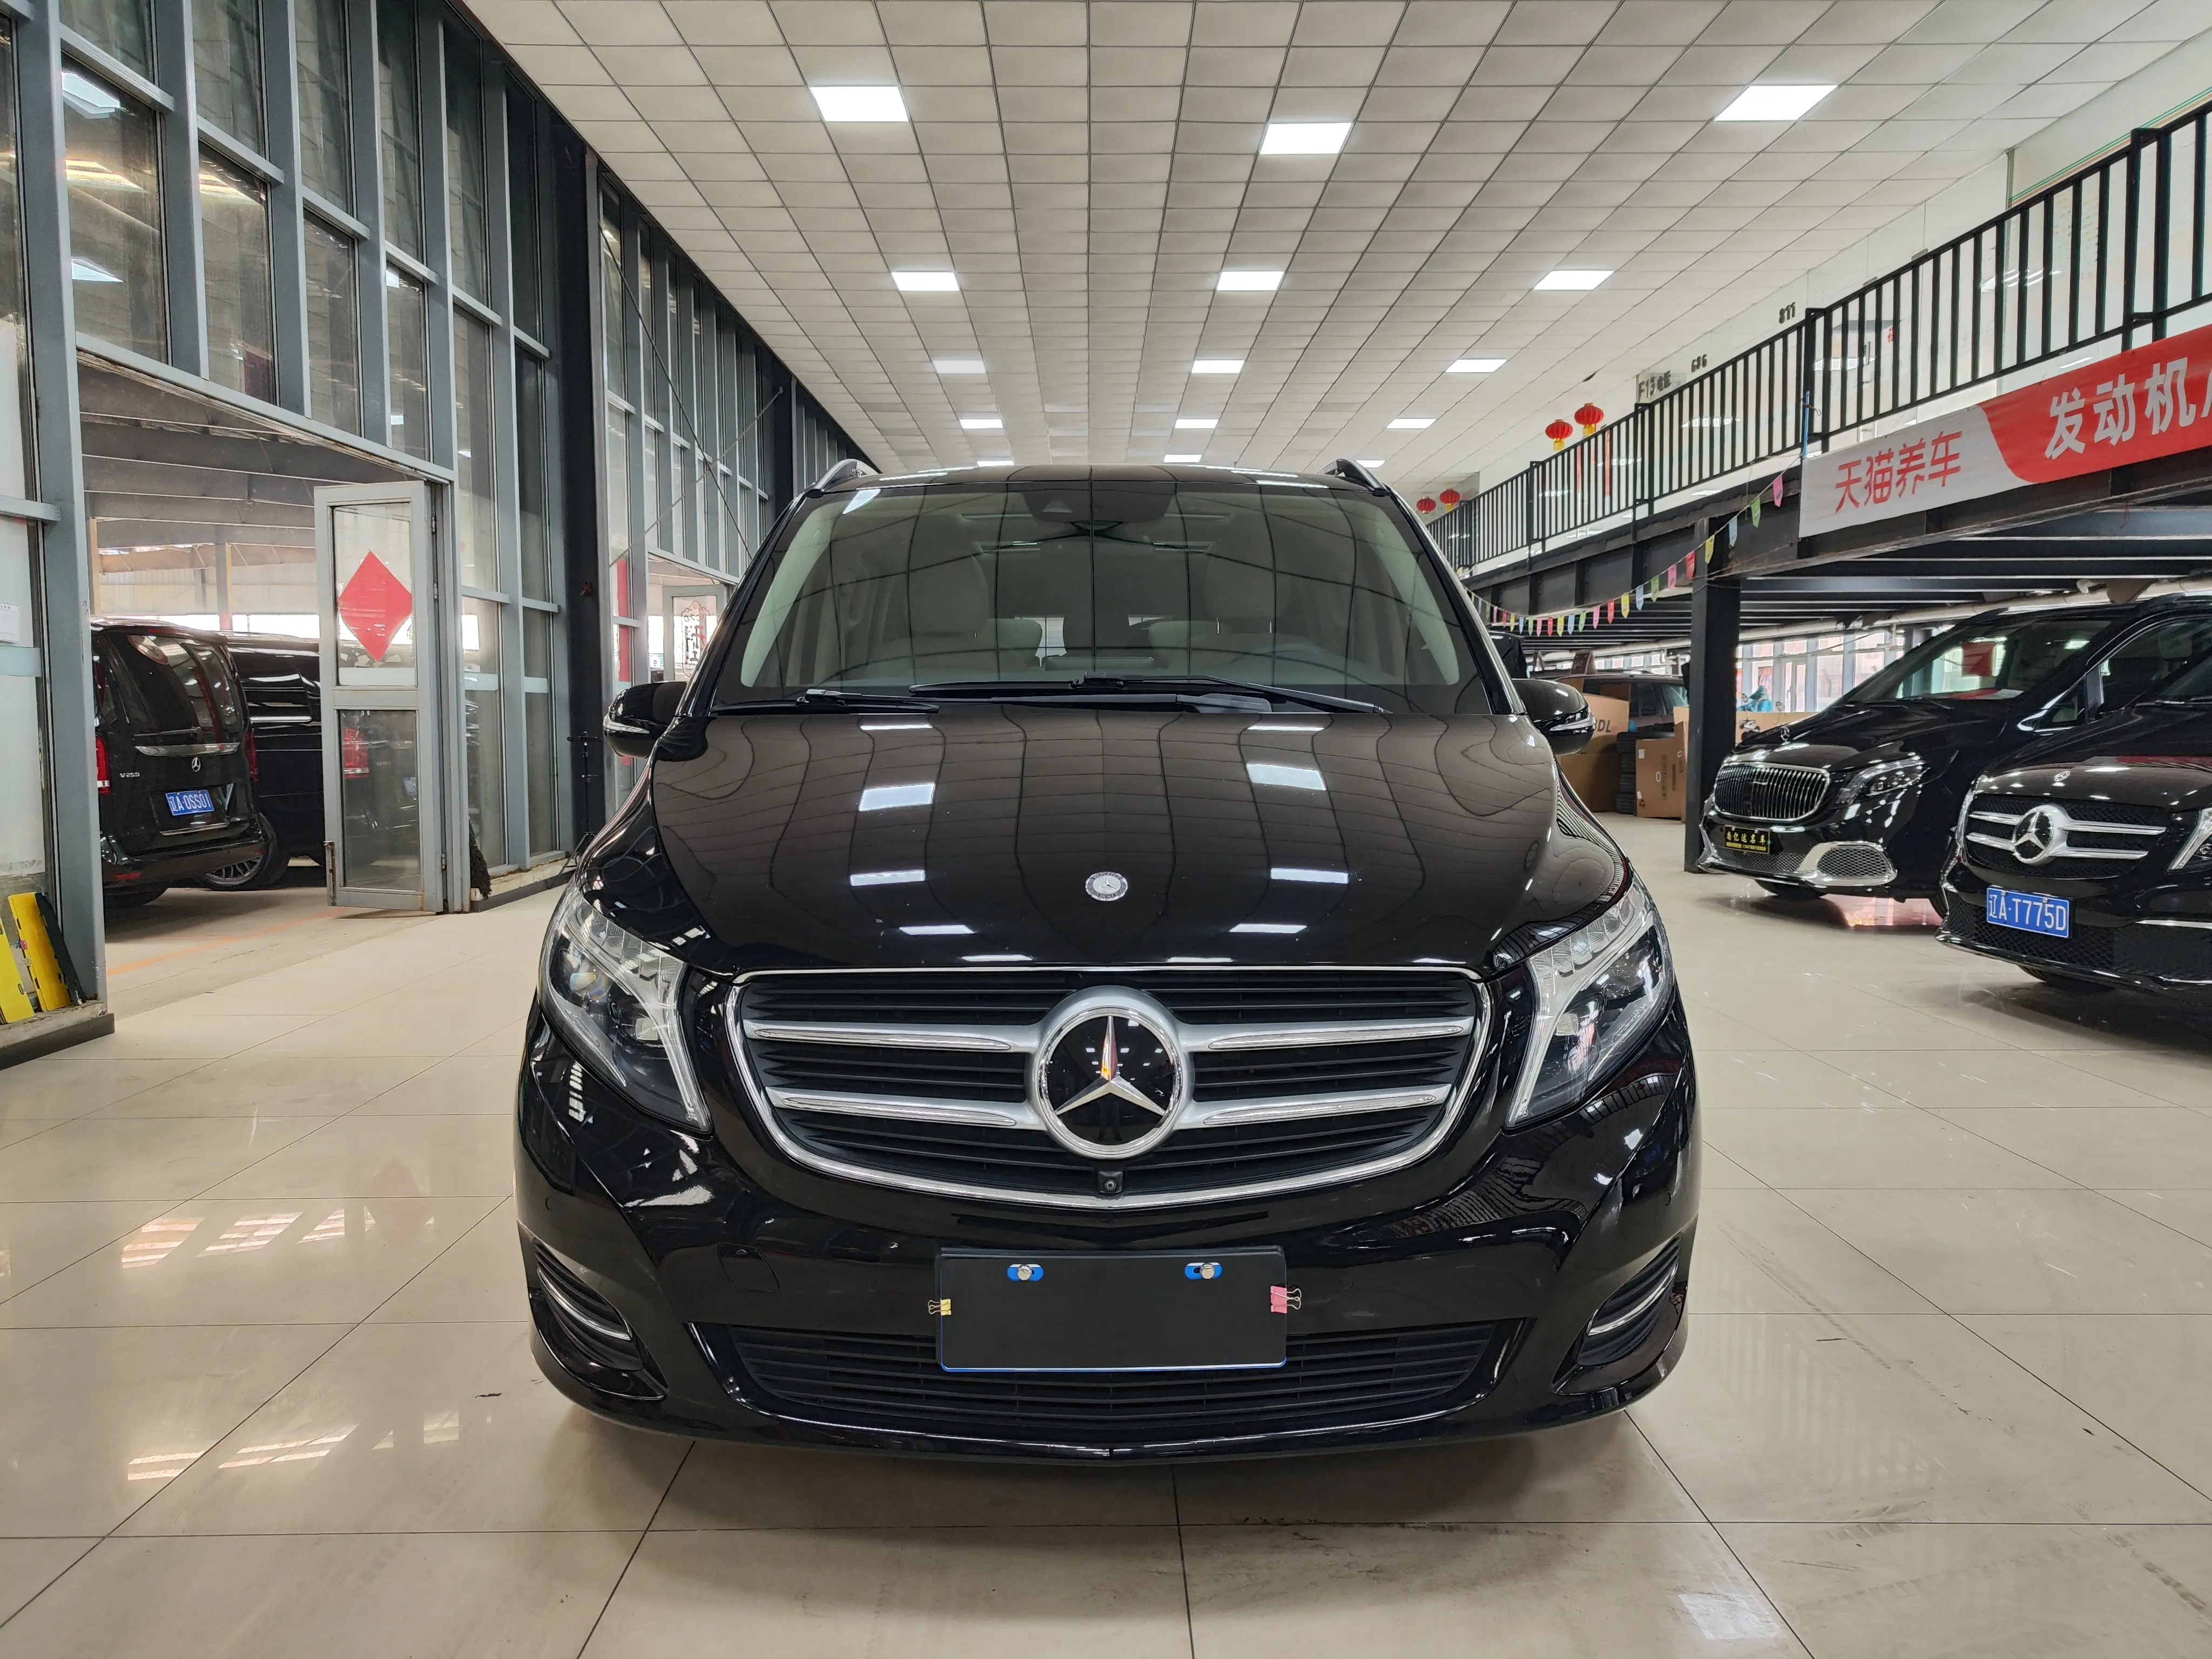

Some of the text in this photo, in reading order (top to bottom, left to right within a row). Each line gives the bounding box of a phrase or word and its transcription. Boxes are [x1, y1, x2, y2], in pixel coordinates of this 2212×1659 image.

[2045, 356, 2212, 459] 发动机
[1835, 431, 1963, 514] 天猫养车
[1594, 719, 1611, 733] DL
